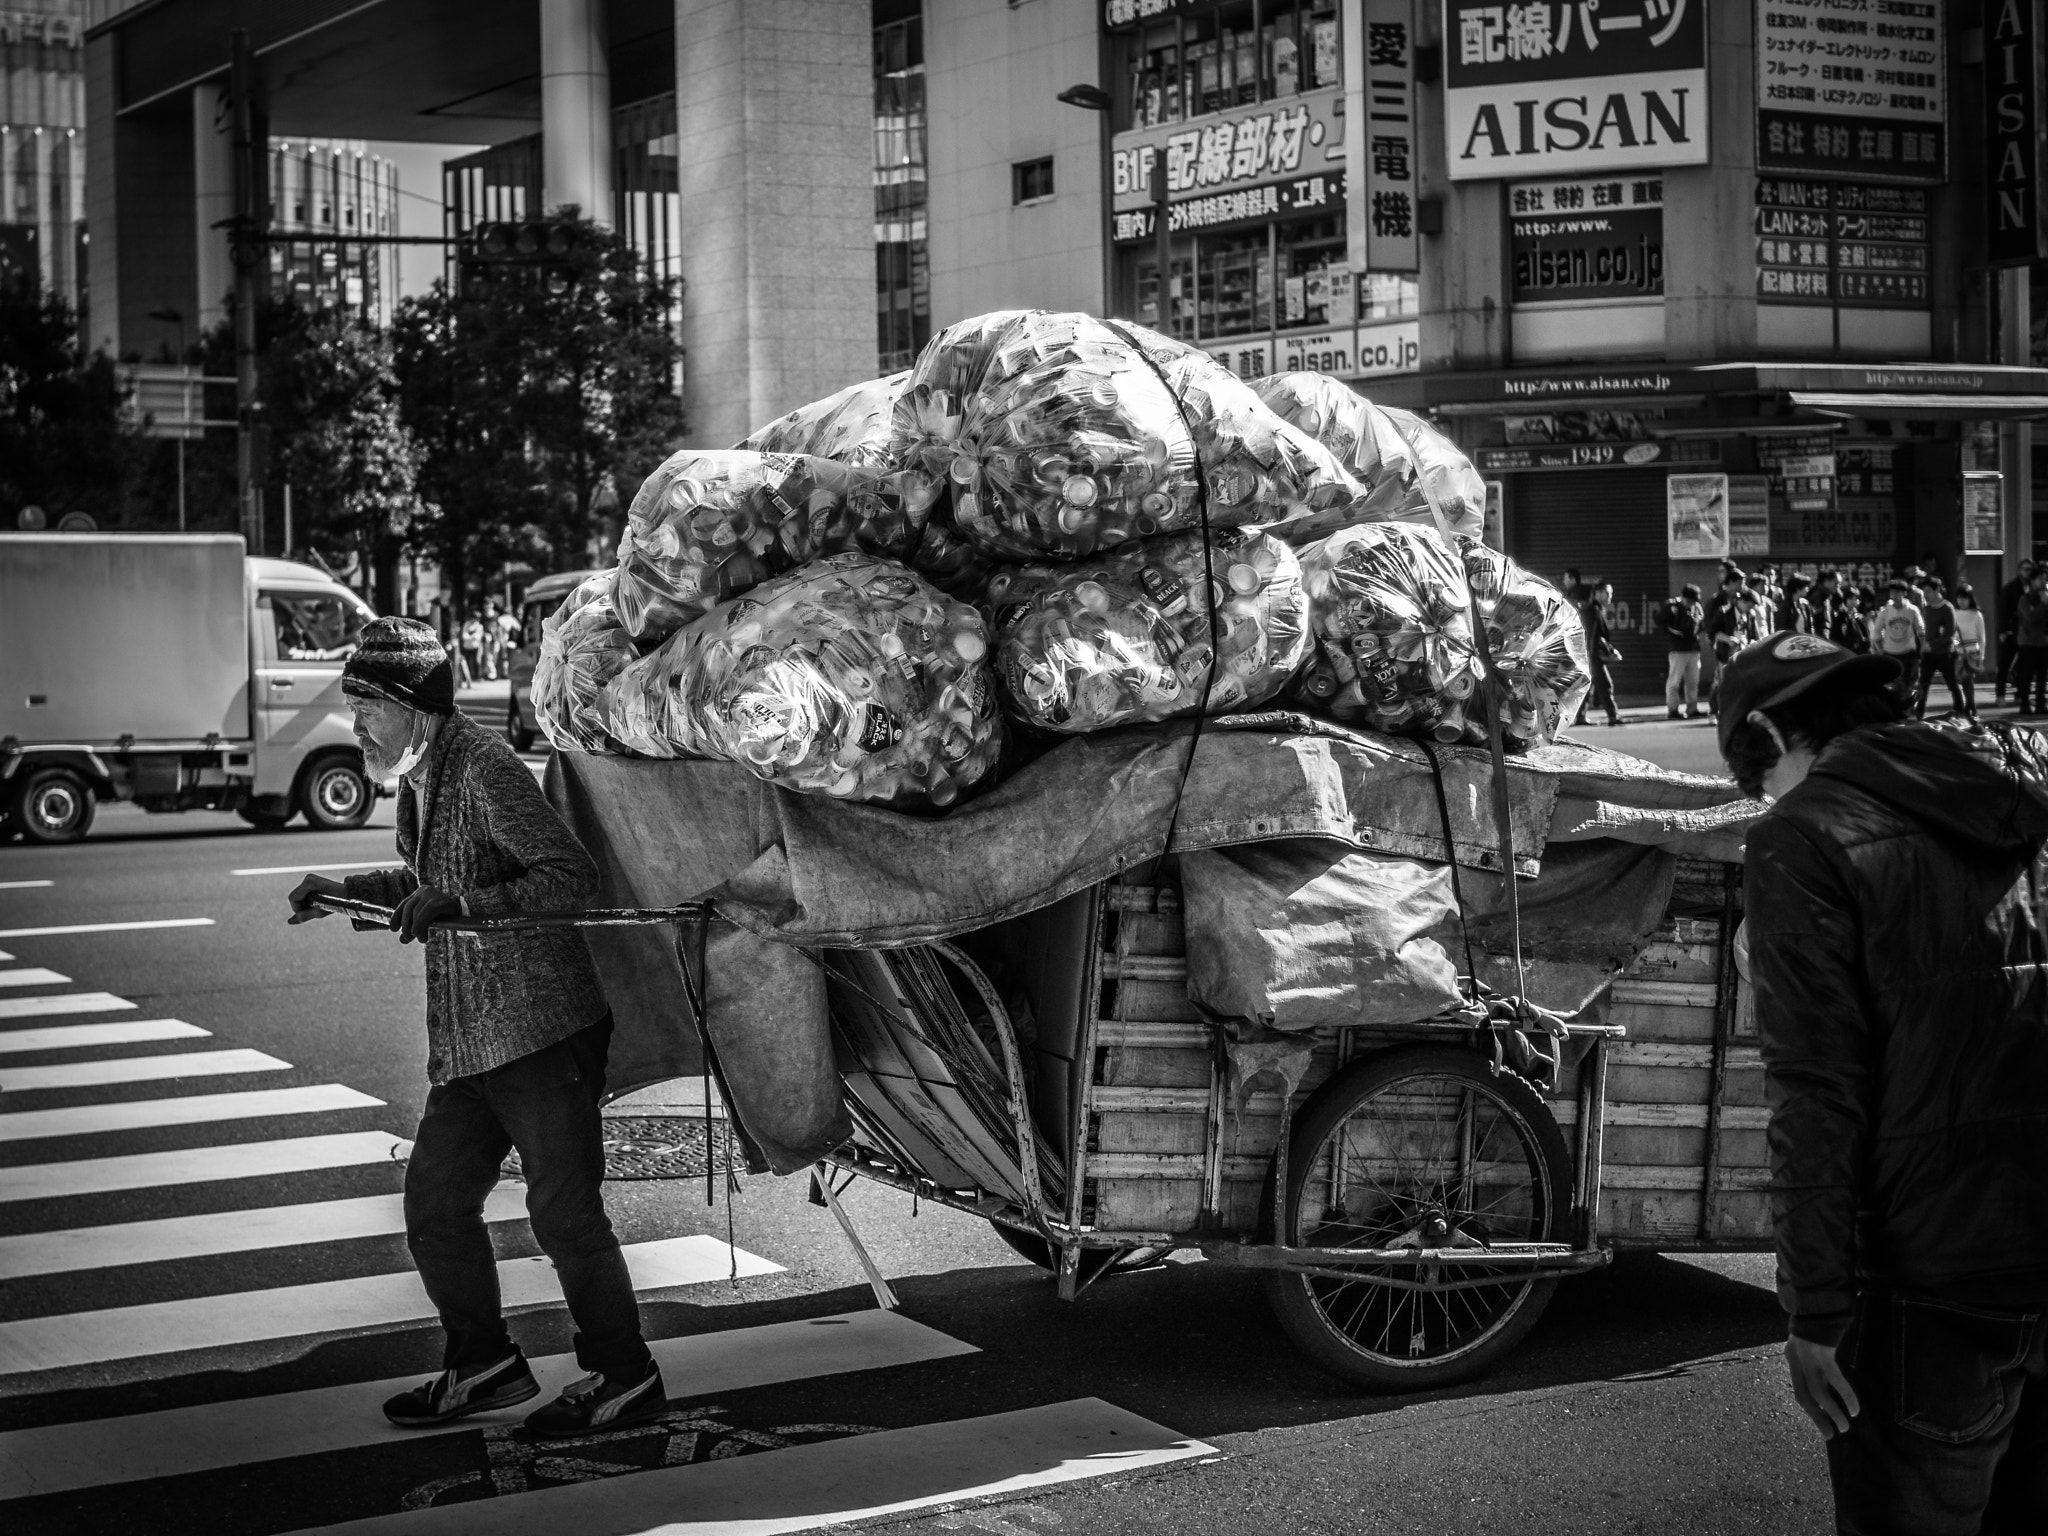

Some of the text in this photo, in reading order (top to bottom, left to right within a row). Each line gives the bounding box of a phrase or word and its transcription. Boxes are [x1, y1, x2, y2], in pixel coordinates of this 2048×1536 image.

[1458, 0, 1686, 65] 配線パーツ
[1369, 21, 1412, 238] 愛三電機
[1459, 88, 1691, 160] AISAN
[1993, 0, 2027, 231] AISAN
[1769, 120, 1805, 153] 各社
[1858, 128, 1894, 160] 在庫
[1113, 146, 1156, 194] B1F
[1513, 188, 1545, 213] 各社
[1552, 184, 1585, 210] 特約
[1592, 181, 1624, 207] 在庫
[1514, 219, 1613, 237] http://www.
[1515, 232, 1664, 291] aisan.co.jp
[1504, 374, 1671, 396] http://www.aisan.co.jp
[1572, 445, 1614, 465] 1949
[1156, 582, 1180, 602] BLACK
